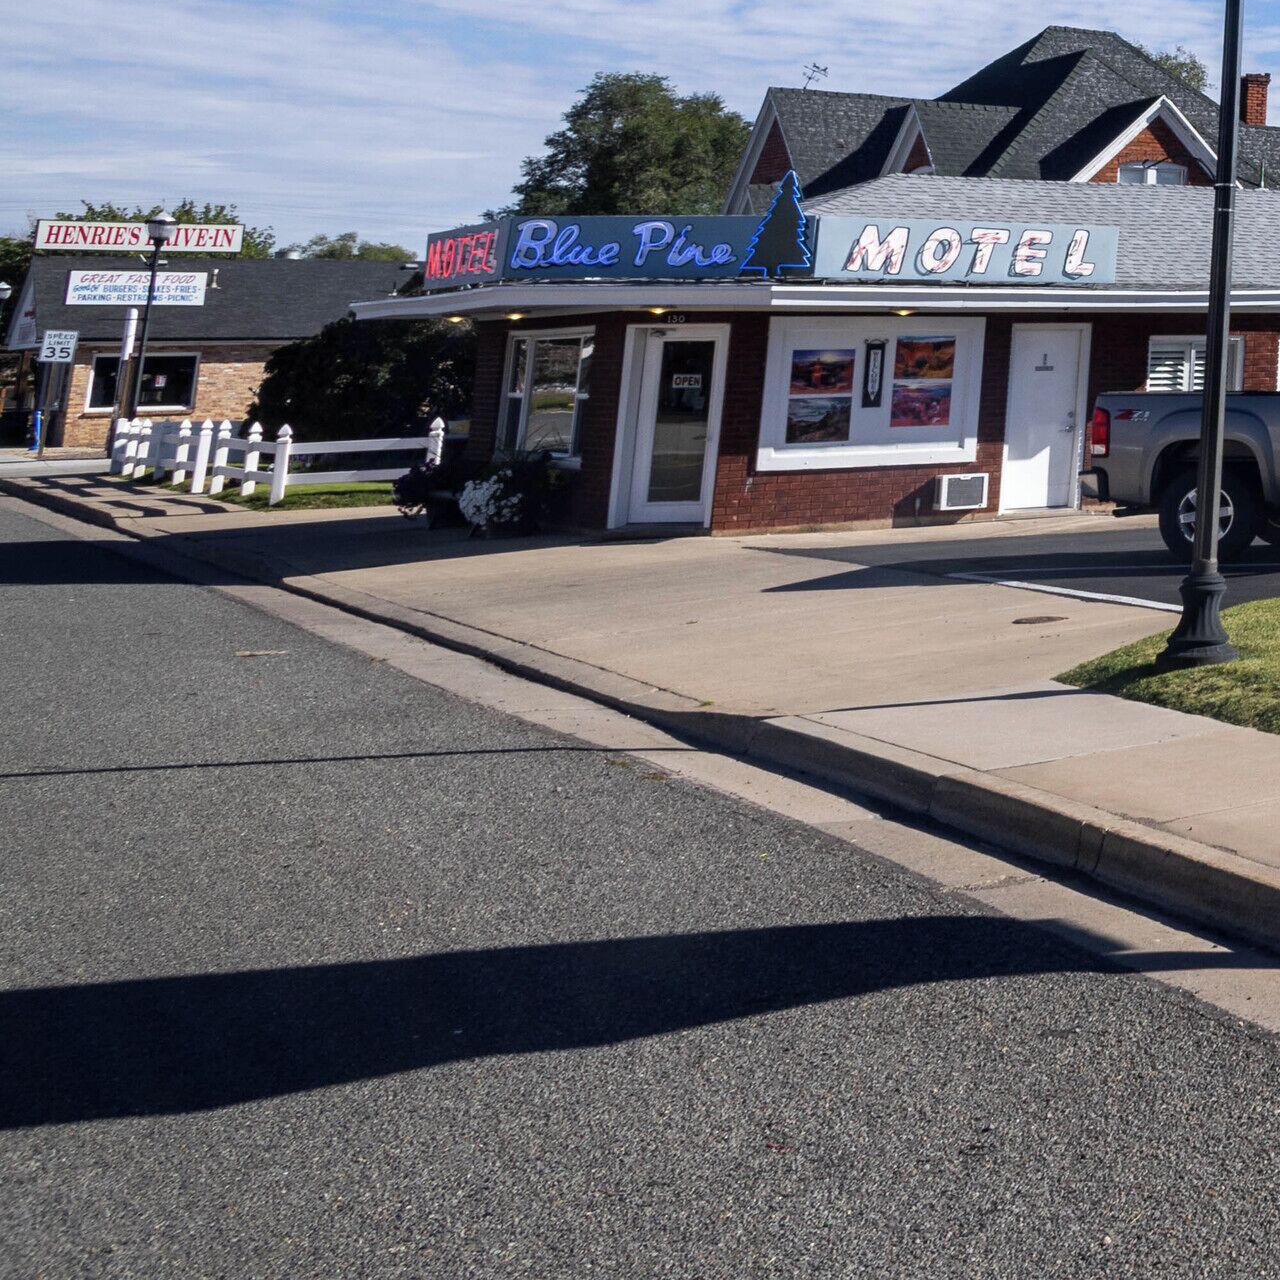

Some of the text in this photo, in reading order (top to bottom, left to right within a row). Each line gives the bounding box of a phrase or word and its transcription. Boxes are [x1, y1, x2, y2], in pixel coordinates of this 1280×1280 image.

[44, 225, 236, 247] HENRIE'S IVE-IN
[510, 219, 737, 269] Blue Pine
[425, 229, 499, 280] MOTEL
[845, 224, 1097, 279] MOTEL
[80, 273, 197, 284] GREAT FAS FOOD
[103, 284, 138, 293] BURGERS
[175, 285, 198, 294] FRIES
[77, 293, 112, 301] PARKING
[167, 294, 194, 302] PICNIC
[667, 315, 686, 323] 130
[44, 346, 71, 359] 35
[674, 375, 701, 387] OPEN
